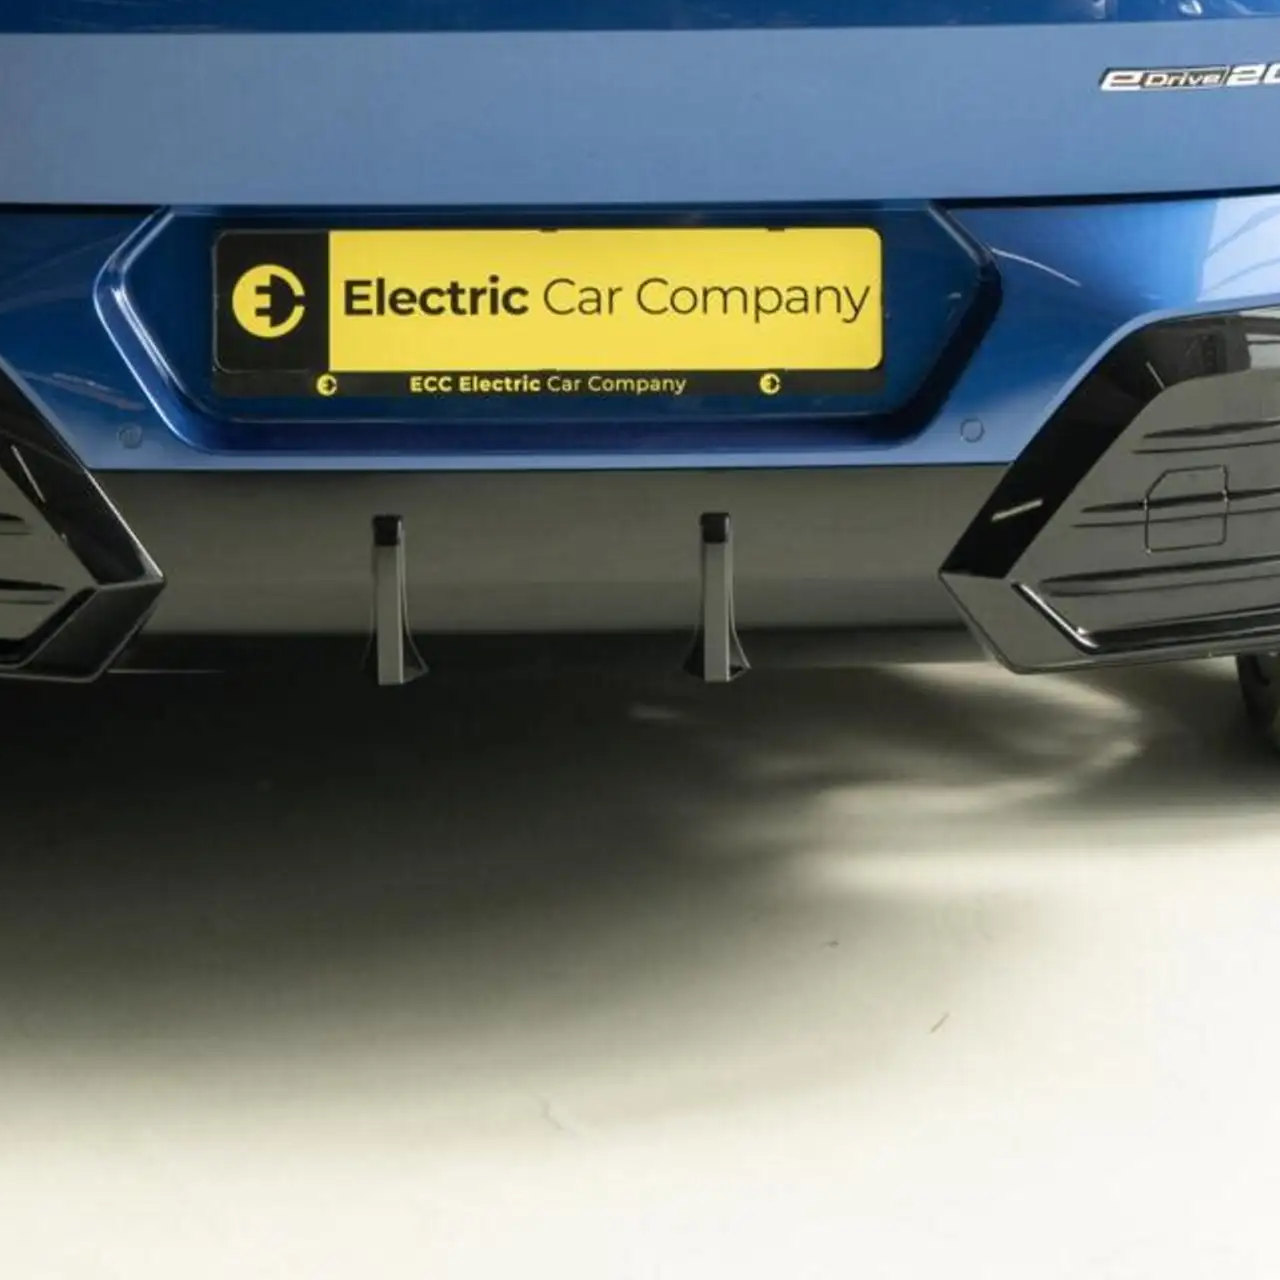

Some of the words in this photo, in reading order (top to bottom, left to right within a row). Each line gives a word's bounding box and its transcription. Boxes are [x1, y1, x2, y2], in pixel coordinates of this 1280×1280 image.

[344, 273, 530, 317] Electric
[543, 277, 623, 316] Car
[636, 277, 872, 324] Company
[410, 375, 453, 393] ECC
[459, 374, 542, 393] Electric
[546, 375, 581, 393] Car
[587, 375, 687, 396] Company
